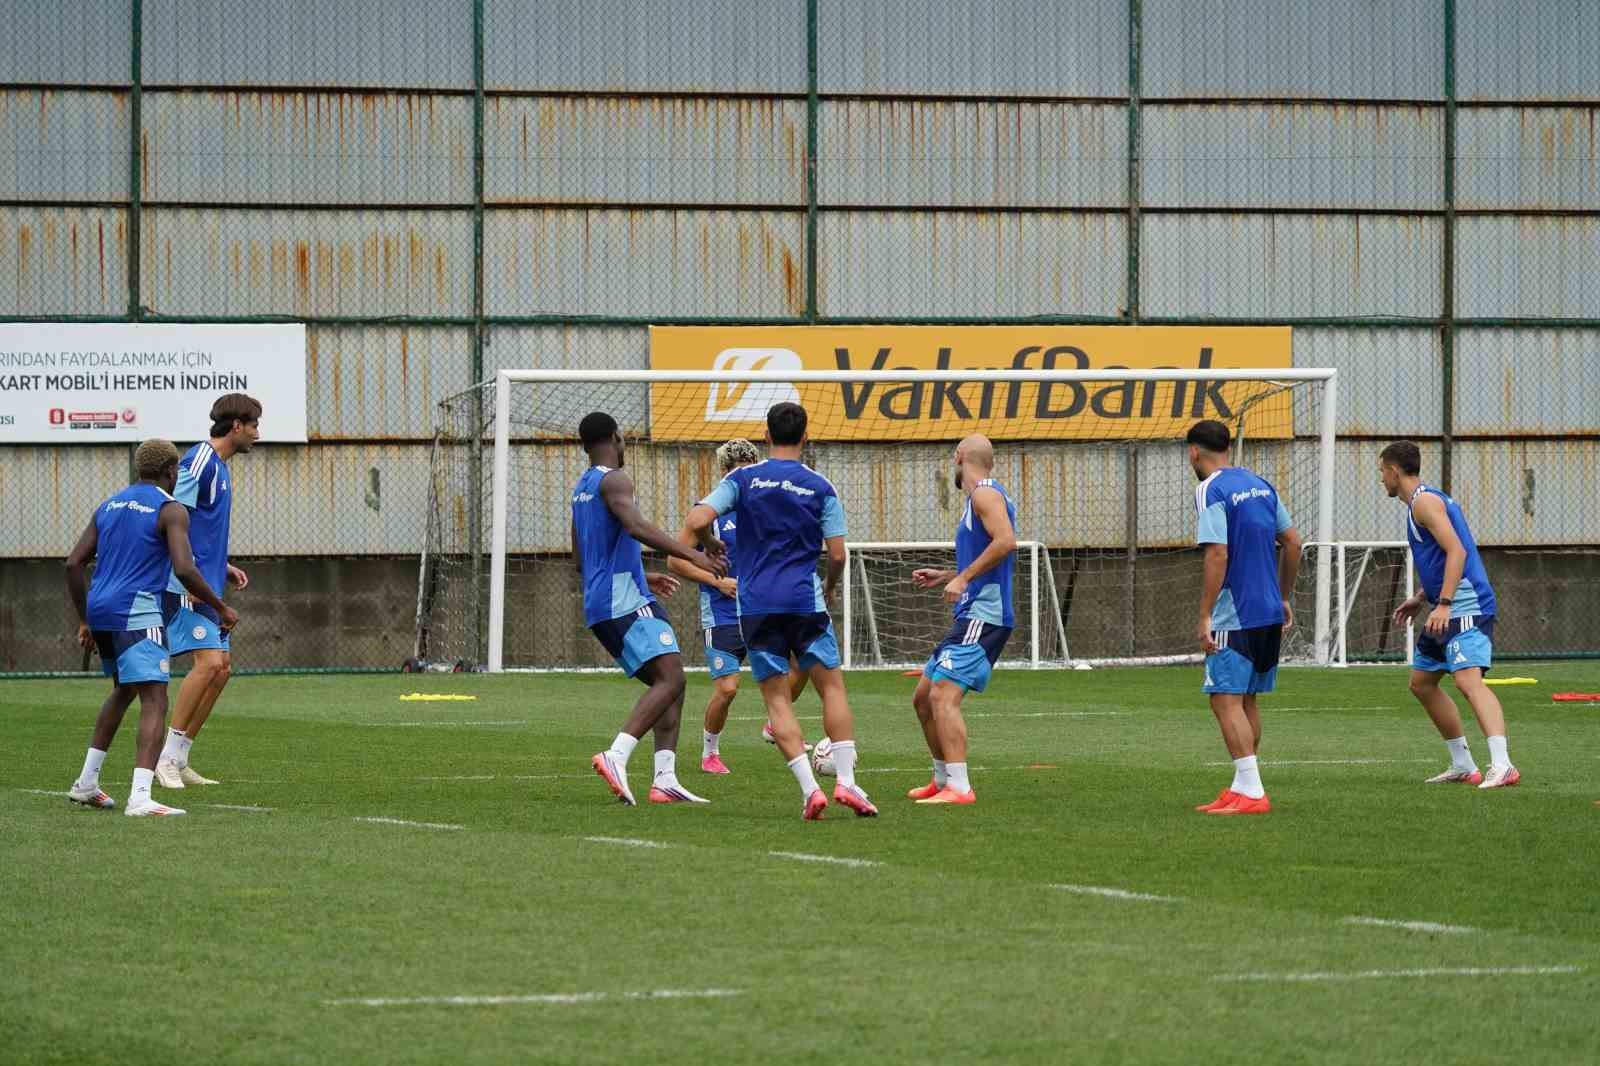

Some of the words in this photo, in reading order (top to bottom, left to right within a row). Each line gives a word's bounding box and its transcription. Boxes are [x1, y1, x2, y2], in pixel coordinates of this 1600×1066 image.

[60, 351, 177, 367] FAYDALANMAK
[182, 350, 212, 369] İÇİN
[0, 375, 42, 391] KART
[46, 371, 109, 391] MOBİL'İ
[114, 375, 175, 391] HEMEN
[181, 371, 248, 391] İNDİRİN
